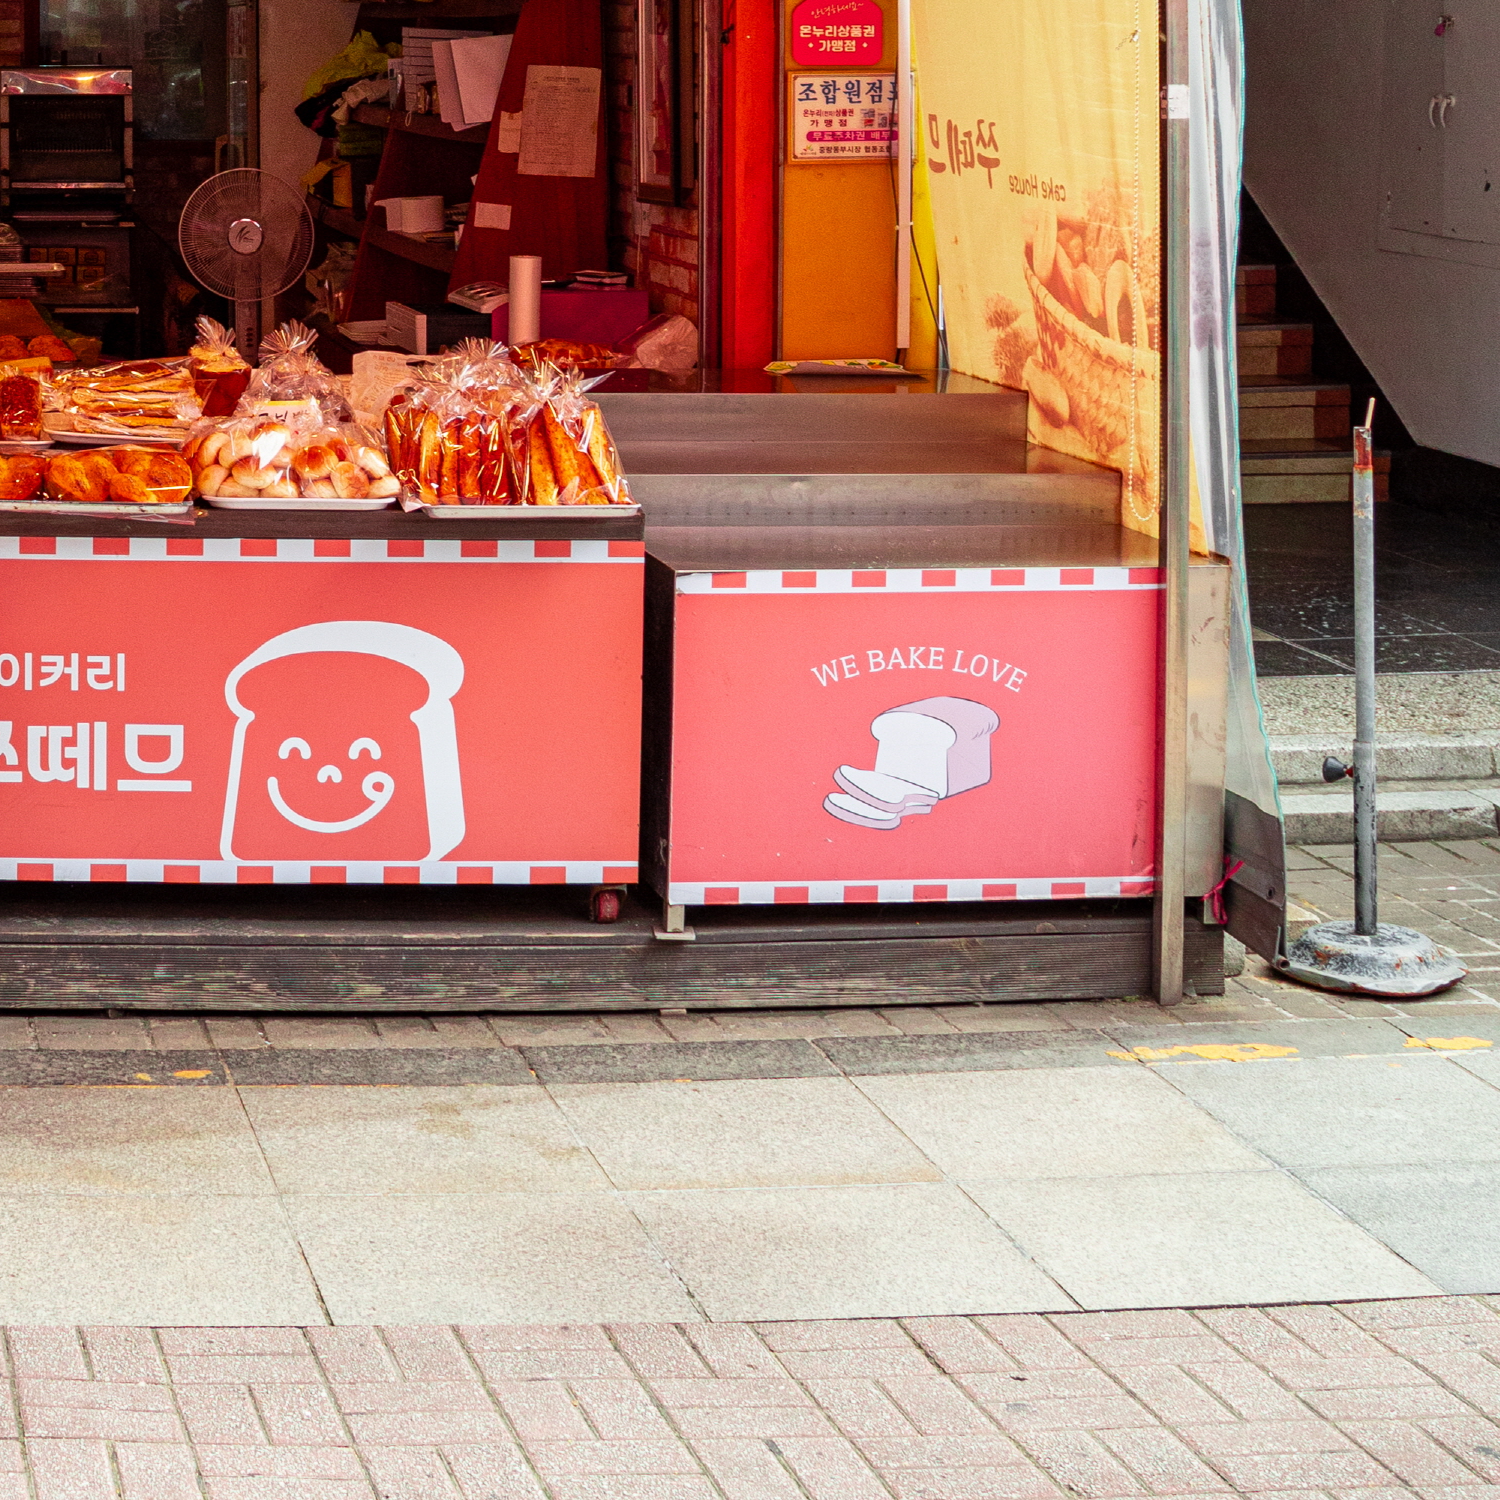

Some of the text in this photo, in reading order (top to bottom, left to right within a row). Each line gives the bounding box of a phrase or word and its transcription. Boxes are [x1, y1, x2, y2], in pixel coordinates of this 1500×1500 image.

[799, 25, 875, 38] 온누리상품권
[818, 39, 857, 52] 가맹점
[810, 119, 847, 128] 가맹점
[812, 130, 866, 141] 무료주차권
[810, 646, 1028, 693] WE BAKE LOVE
